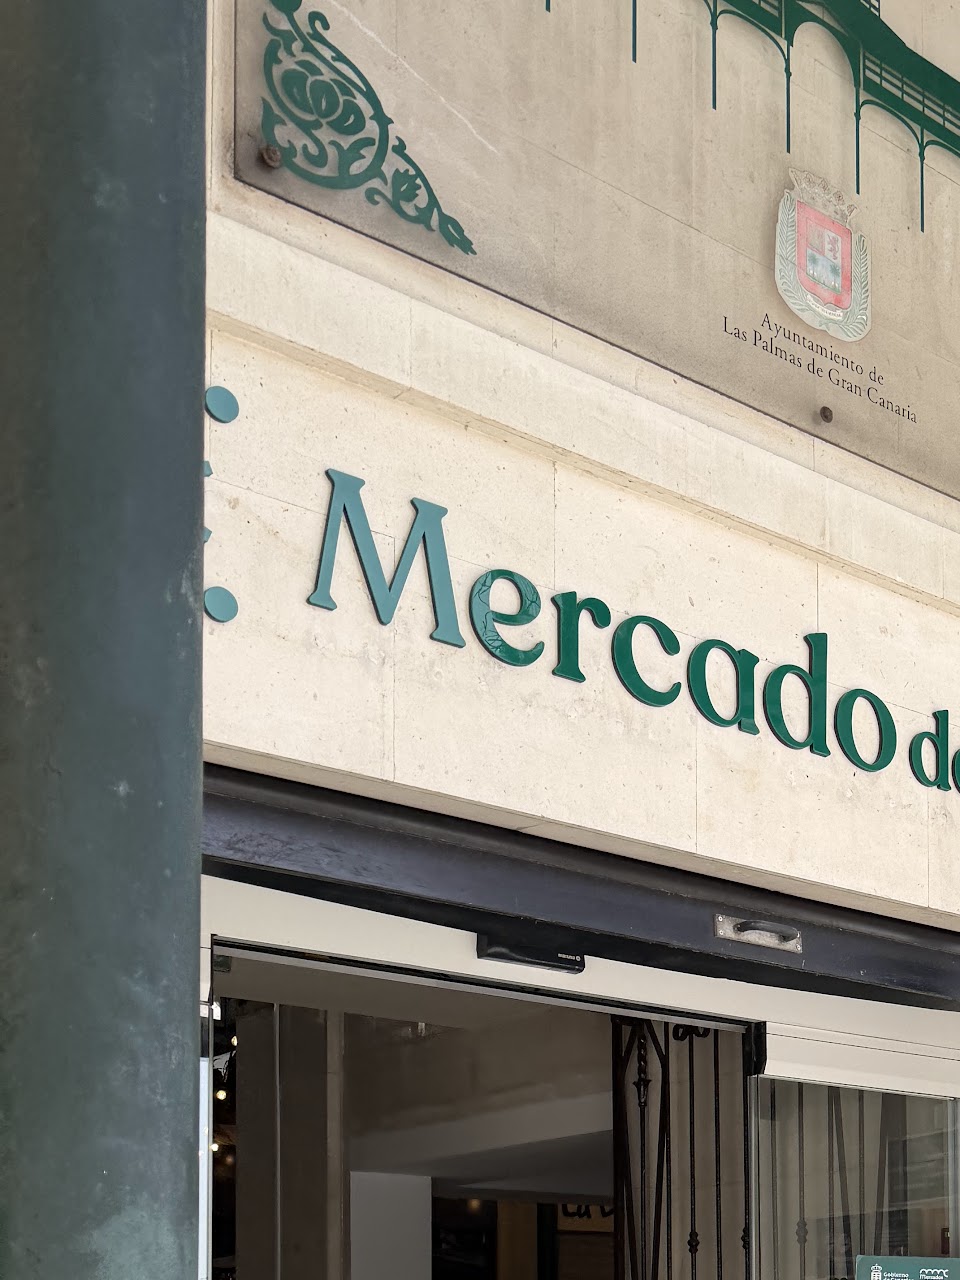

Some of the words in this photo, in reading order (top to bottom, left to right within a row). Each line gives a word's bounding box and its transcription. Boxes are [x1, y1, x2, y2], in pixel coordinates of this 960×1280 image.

[723, 315, 747, 342] Las
[753, 329, 802, 368] Palmas
[807, 358, 823, 378] de
[828, 368, 862, 397] Gran
[867, 387, 917, 424] Canaria
[761, 313, 863, 375] Ayuntamiento
[869, 366, 884, 385] de
[307, 467, 897, 773] Mercado
